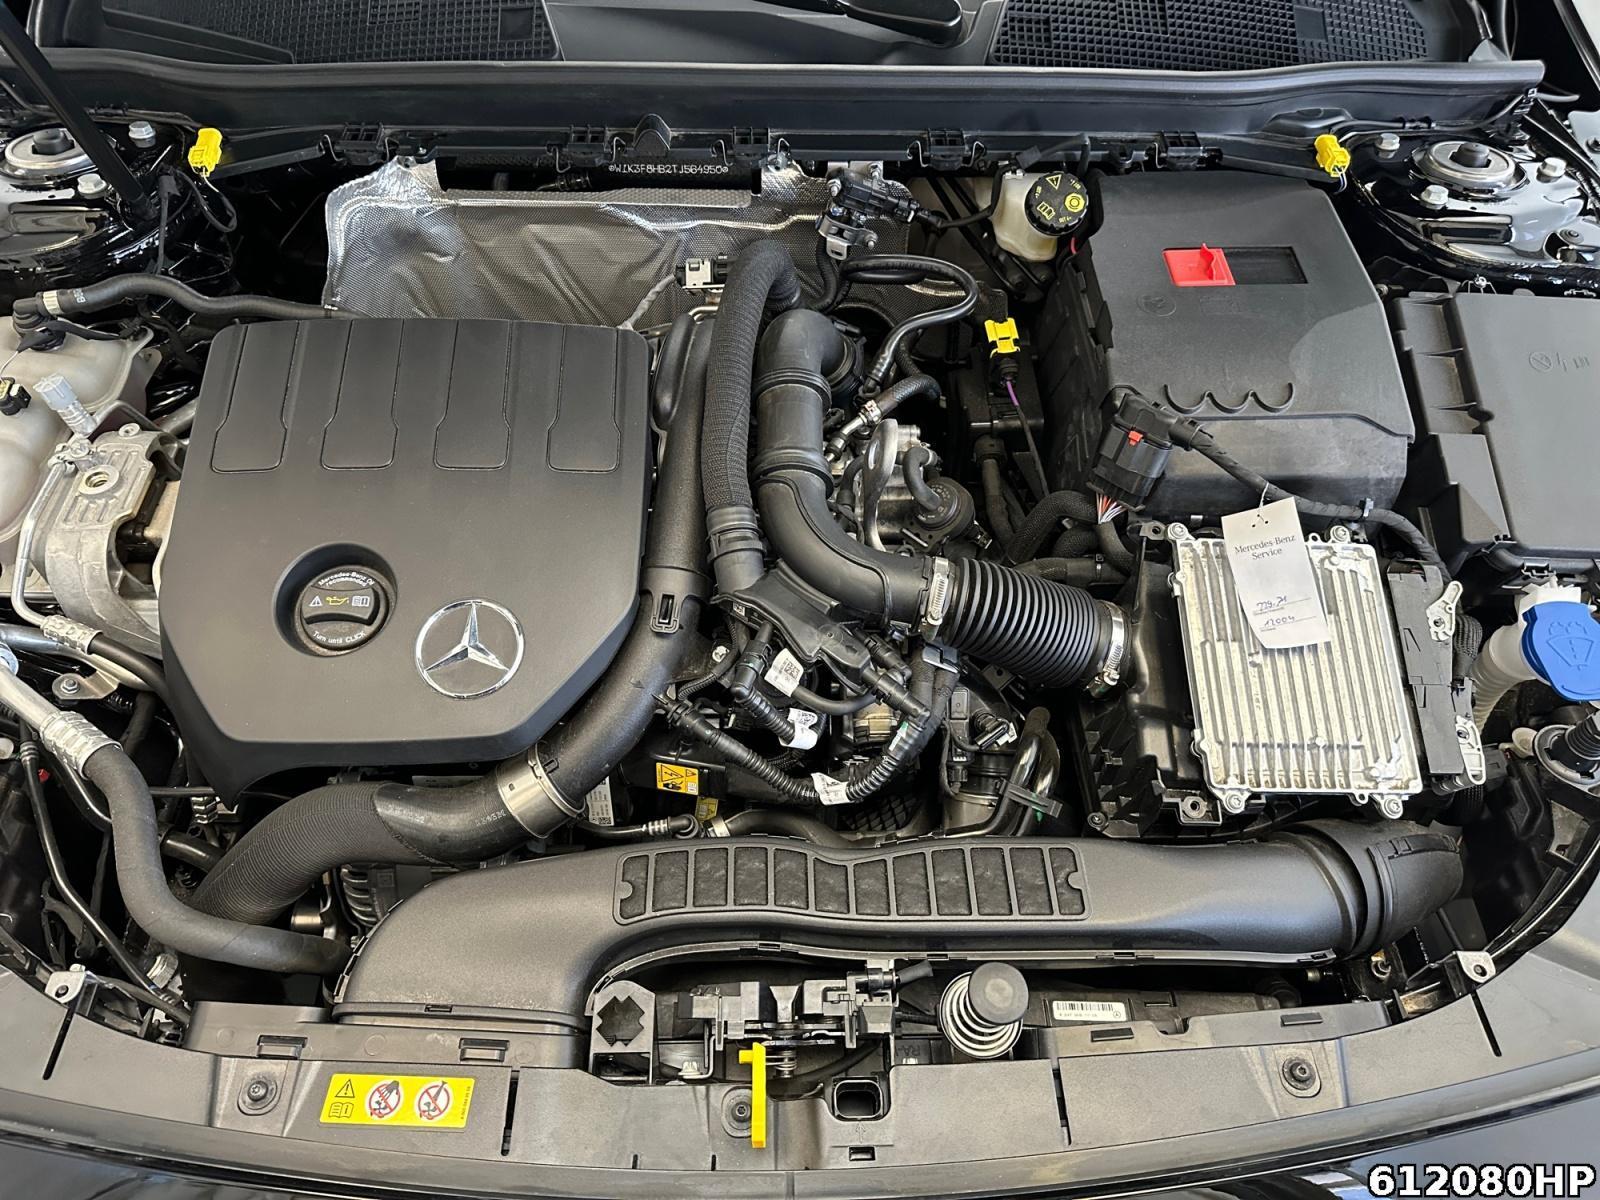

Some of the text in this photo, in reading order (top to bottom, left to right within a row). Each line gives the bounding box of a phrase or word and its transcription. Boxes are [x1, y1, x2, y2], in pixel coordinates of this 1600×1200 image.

[1234, 533, 1297, 556] Mercedes-Benz
[1251, 546, 1284, 561] Service
[312, 630, 367, 645] Turn until CLICK
